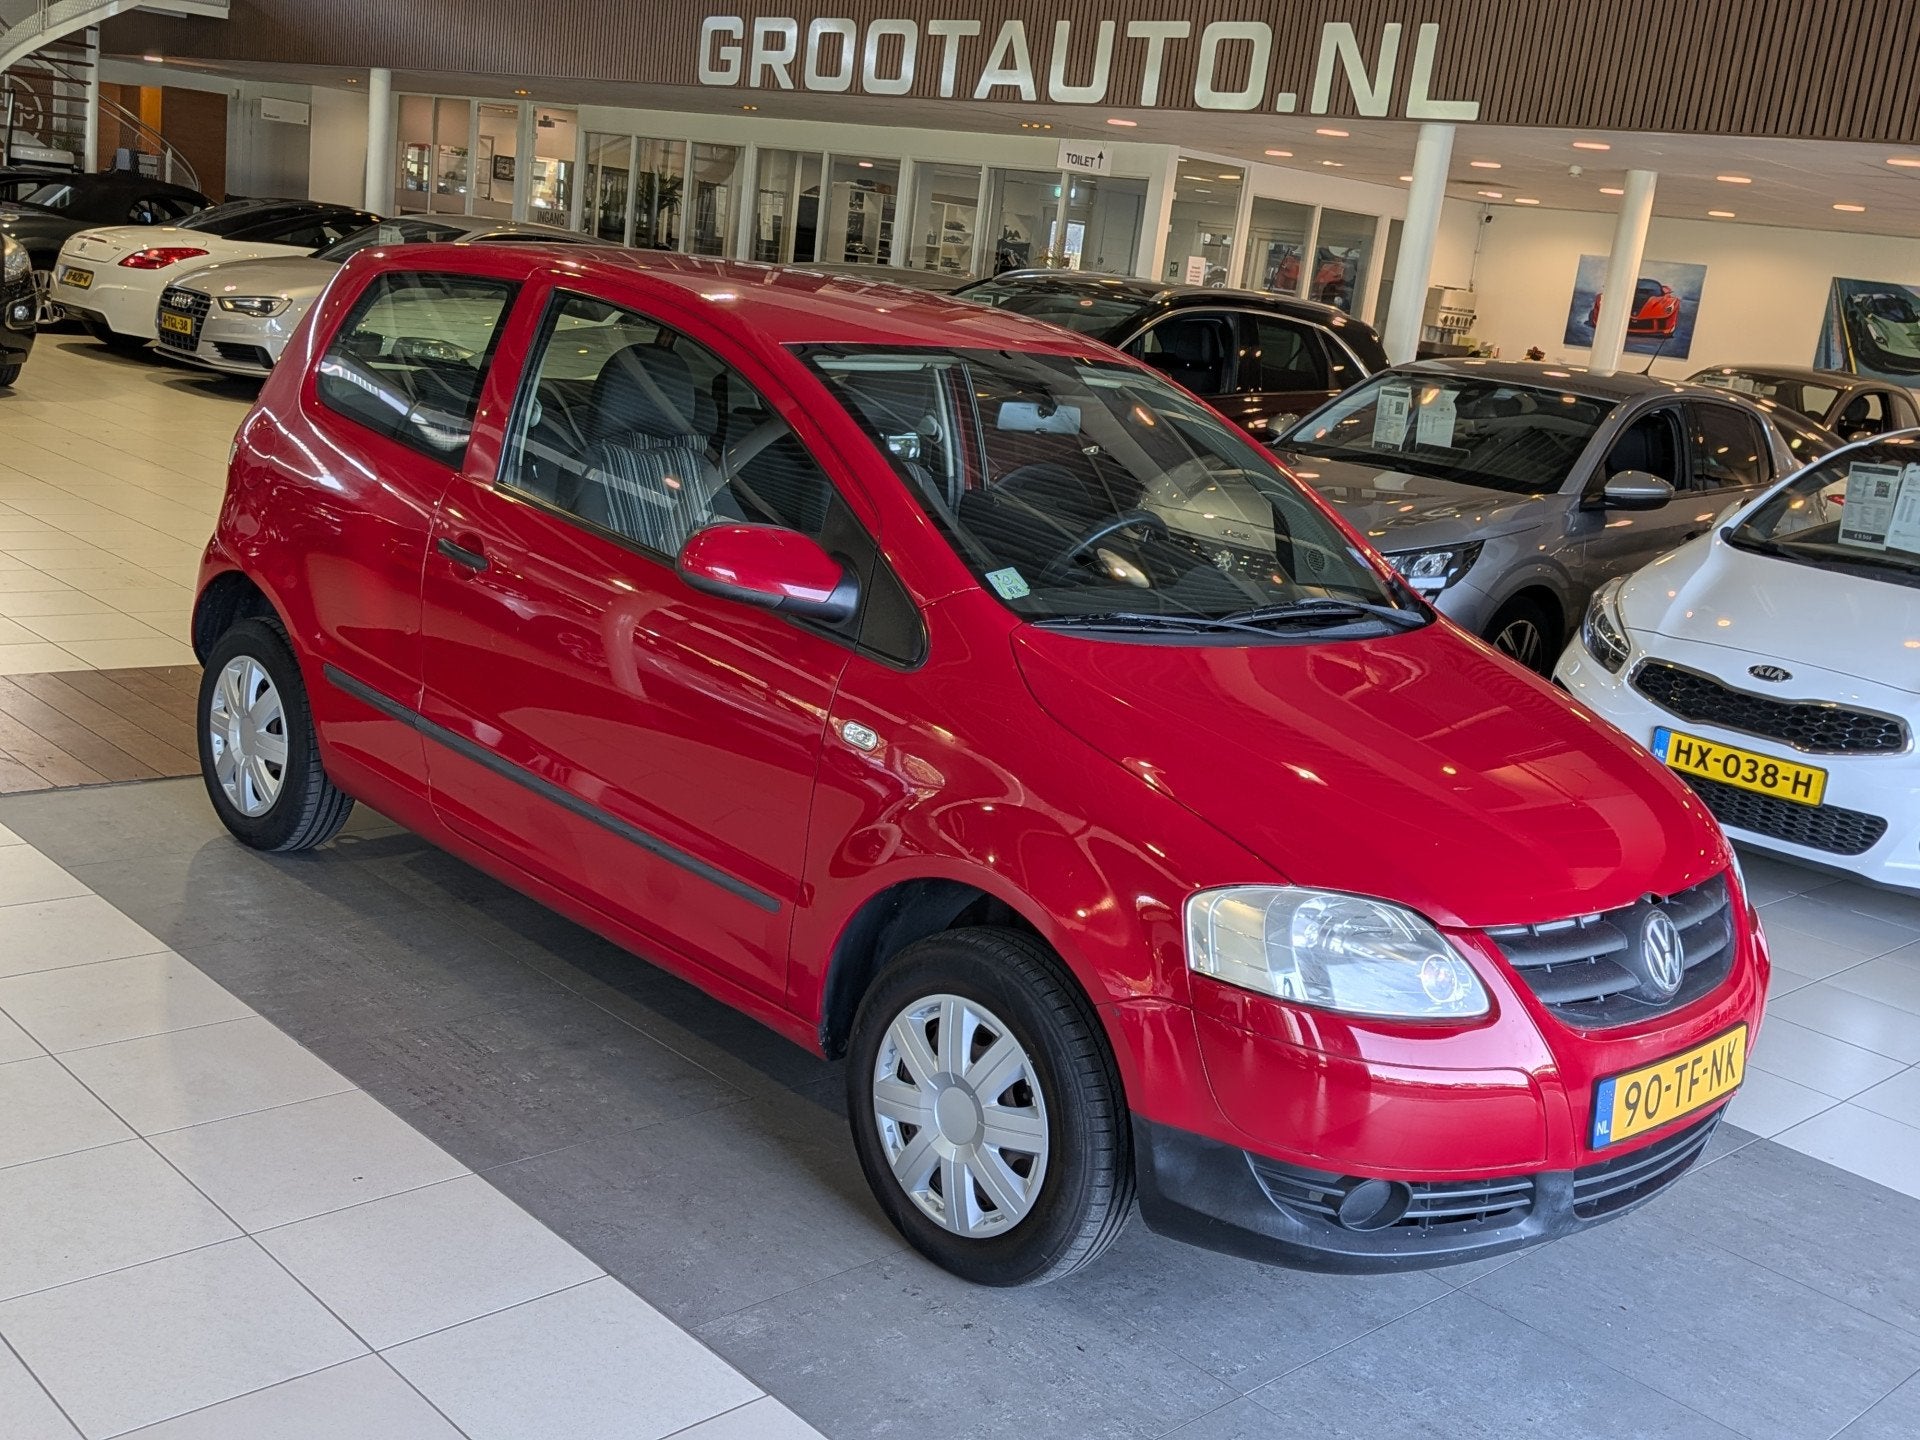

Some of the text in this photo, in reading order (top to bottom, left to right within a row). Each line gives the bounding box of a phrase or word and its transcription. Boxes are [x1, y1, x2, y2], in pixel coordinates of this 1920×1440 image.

[698, 15, 1480, 121] GROOTAUTO.NL
[1066, 152, 1096, 168] TOILET
[536, 209, 566, 226] INGANG
[1753, 666, 1785, 680] KIA
[1654, 747, 1666, 759] NL
[1673, 739, 1814, 798] HX-038-H
[1624, 1037, 1738, 1129] 90-TF-NK
[1596, 1119, 1610, 1137] NL
